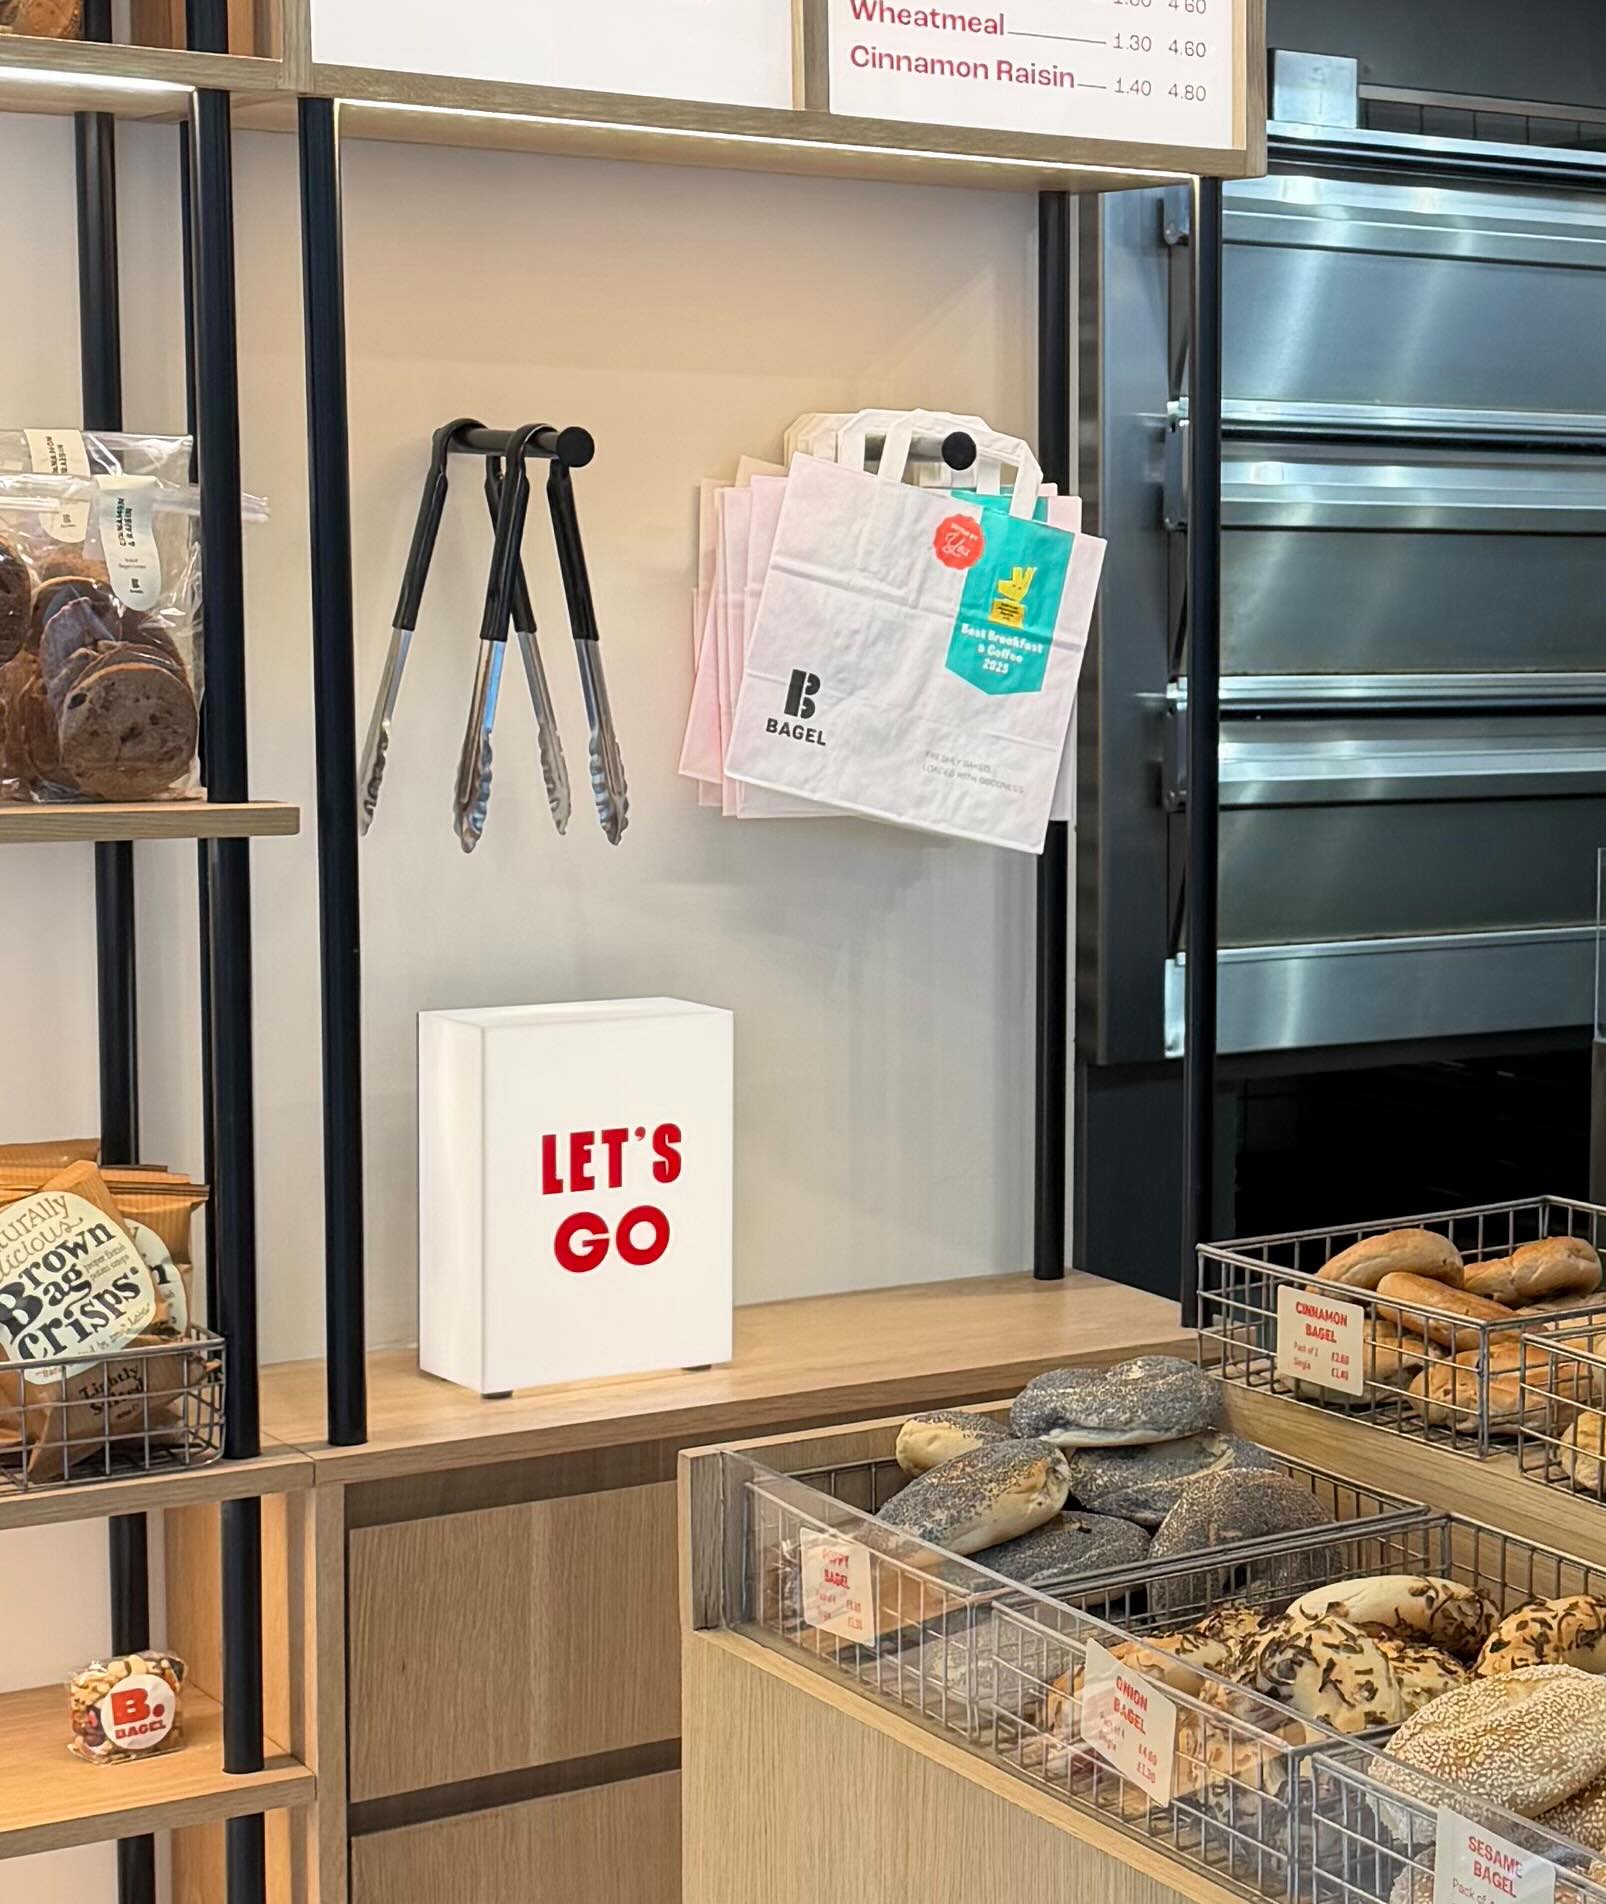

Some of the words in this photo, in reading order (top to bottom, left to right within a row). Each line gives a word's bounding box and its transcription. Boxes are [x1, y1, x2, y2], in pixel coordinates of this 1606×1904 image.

[1112, 32, 1152, 53] 1.30
[1168, 39, 1207, 58] 4.60
[850, 44, 989, 80] Cinnamon
[996, 59, 1075, 89] Raisin
[1114, 77, 1152, 97] 1.40
[1167, 83, 1207, 102] 4.80
[961, 623, 987, 639] Best
[987, 629, 1044, 654] Breakfast
[987, 644, 1024, 664] Coffee
[784, 668, 822, 720] B
[765, 717, 827, 747] BAGEL
[541, 1122, 683, 1195] LET'S
[553, 1204, 671, 1274] GO
[1296, 1301, 1348, 1327] CINNAMON
[1305, 1323, 1337, 1343] BAGEL
[110, 1688, 166, 1728] B.
[1116, 1675, 1148, 1712] ONION
[114, 1719, 168, 1741] BAGEL
[1113, 1697, 1146, 1735] BAGEL
[1467, 1835, 1524, 1879] SESAME
[1473, 1860, 1517, 1899] BAGEL
